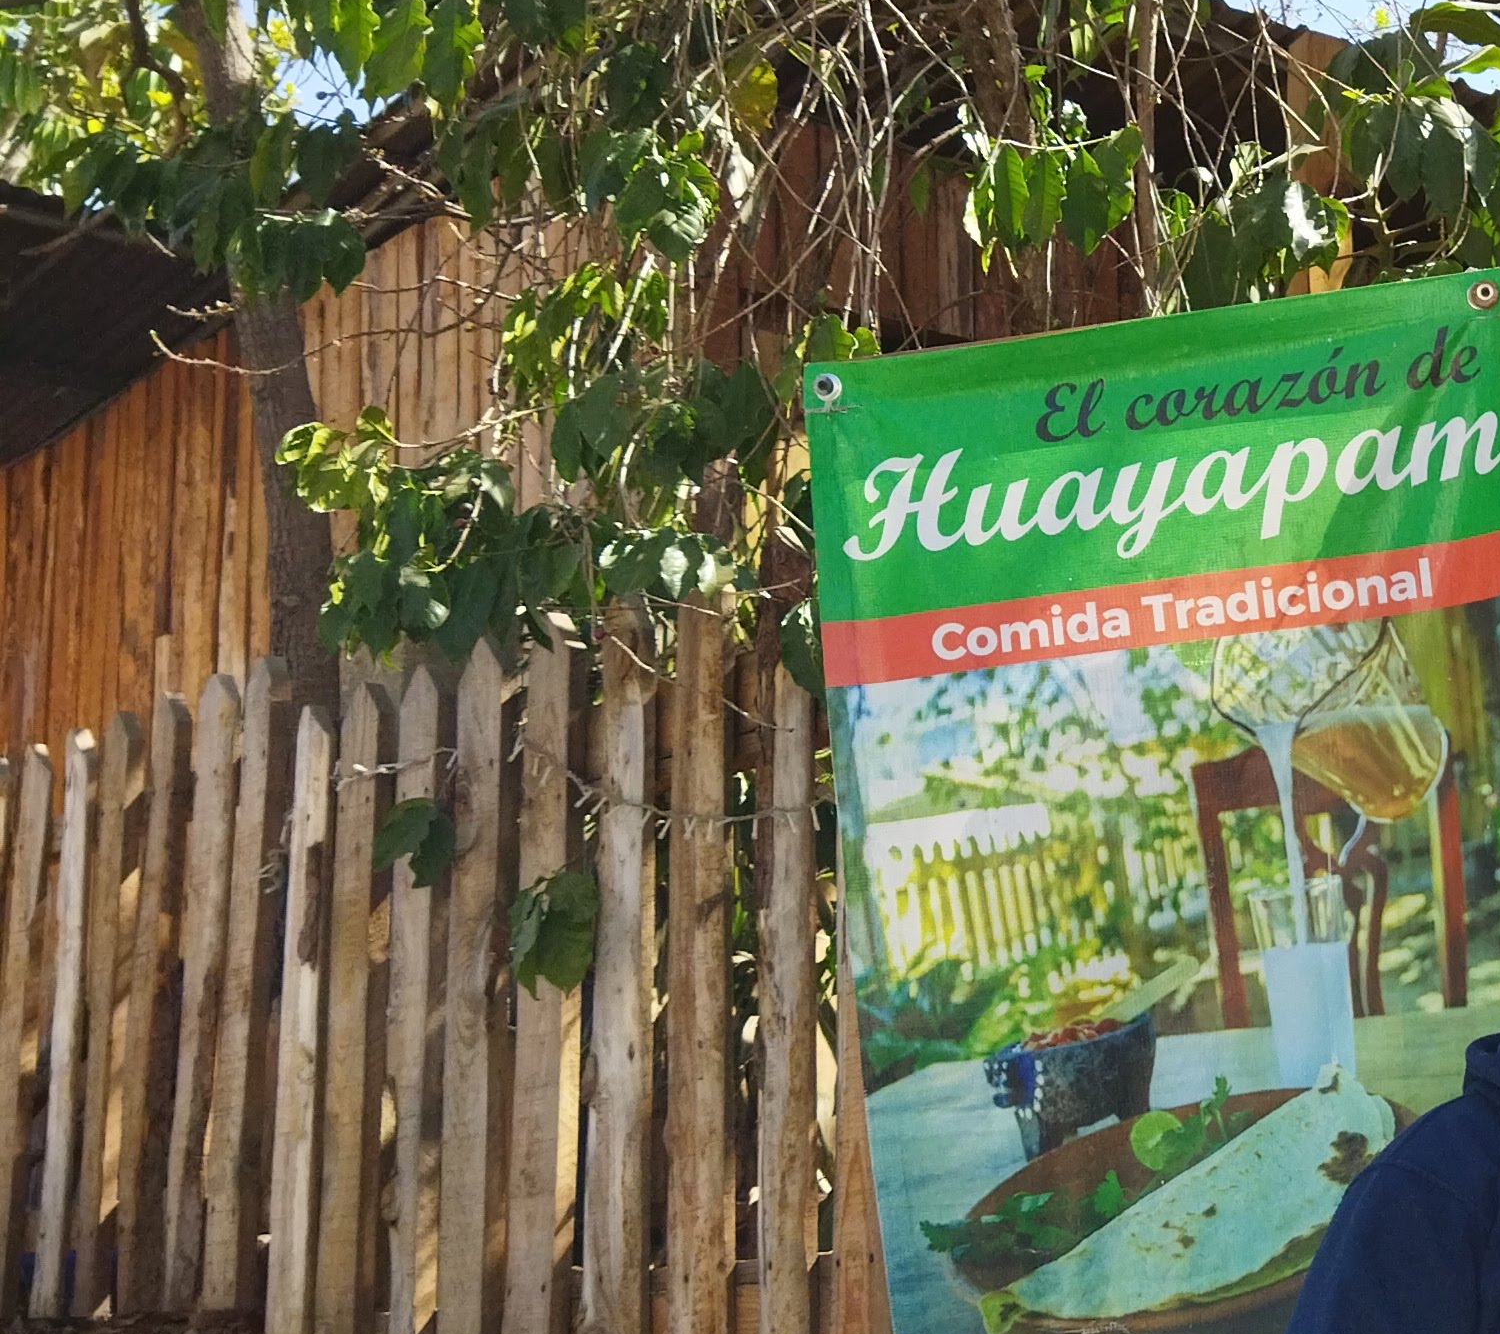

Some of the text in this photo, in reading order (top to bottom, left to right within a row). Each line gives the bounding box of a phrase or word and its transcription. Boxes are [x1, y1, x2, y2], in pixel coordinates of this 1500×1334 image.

[1034, 326, 1482, 442] El corazón de
[931, 557, 1434, 661] Comida Tradicional
